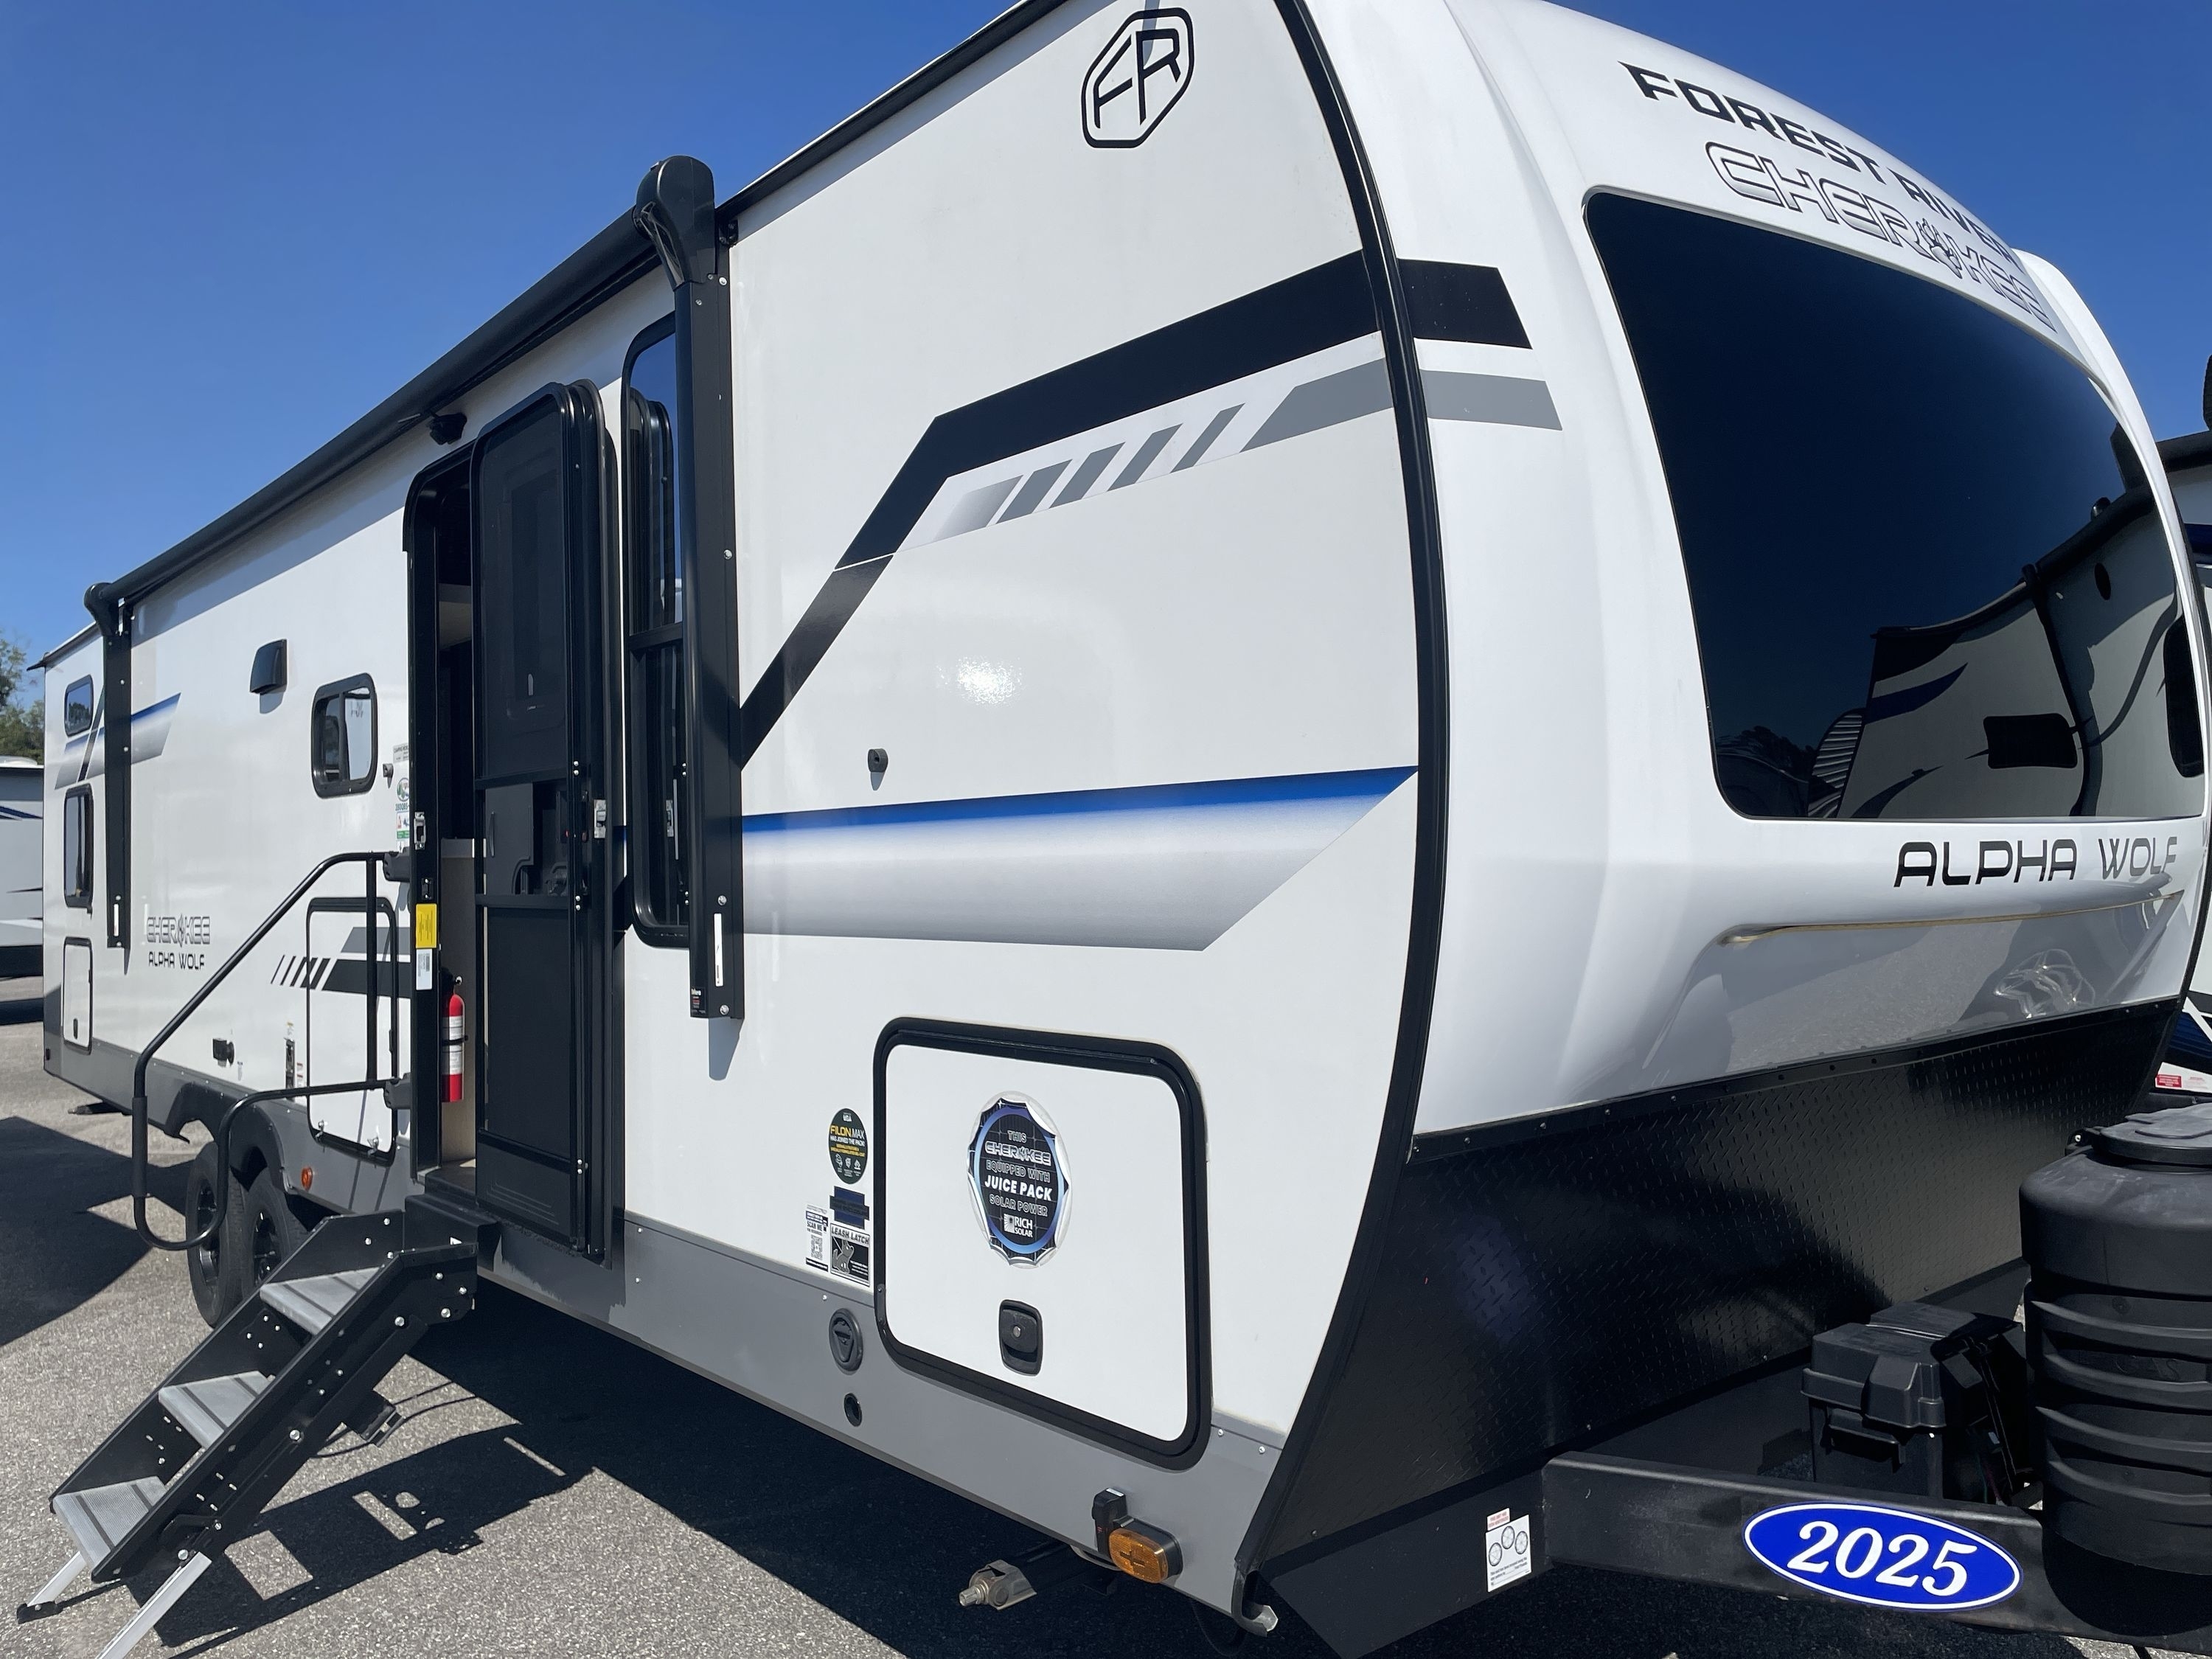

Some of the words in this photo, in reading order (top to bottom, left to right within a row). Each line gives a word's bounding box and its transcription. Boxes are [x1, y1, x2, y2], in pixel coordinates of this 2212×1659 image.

[1618, 61, 1888, 185] FOREST
[1886, 167, 2025, 275] RIVER
[1893, 838, 2078, 888] ALPHA
[2098, 836, 2177, 880] WOLF
[148, 951, 175, 969] ALPHA
[179, 953, 205, 970] WOLF
[1007, 1130, 1027, 1143] THIS
[986, 1160, 1026, 1178] EQUIPPED
[1028, 1167, 1051, 1183] WITH
[984, 1175, 1018, 1194] JUICE
[1020, 1181, 1053, 1201] PACK
[990, 1194, 1016, 1211] SOLAR
[1018, 1201, 1048, 1217] POWER
[1014, 1217, 1033, 1230] RICH
[1014, 1227, 1033, 1238] SOLAR
[831, 1226, 849, 1239] LEASH
[851, 1233, 869, 1245] LATCH
[1787, 1520, 1978, 1596] 2025
